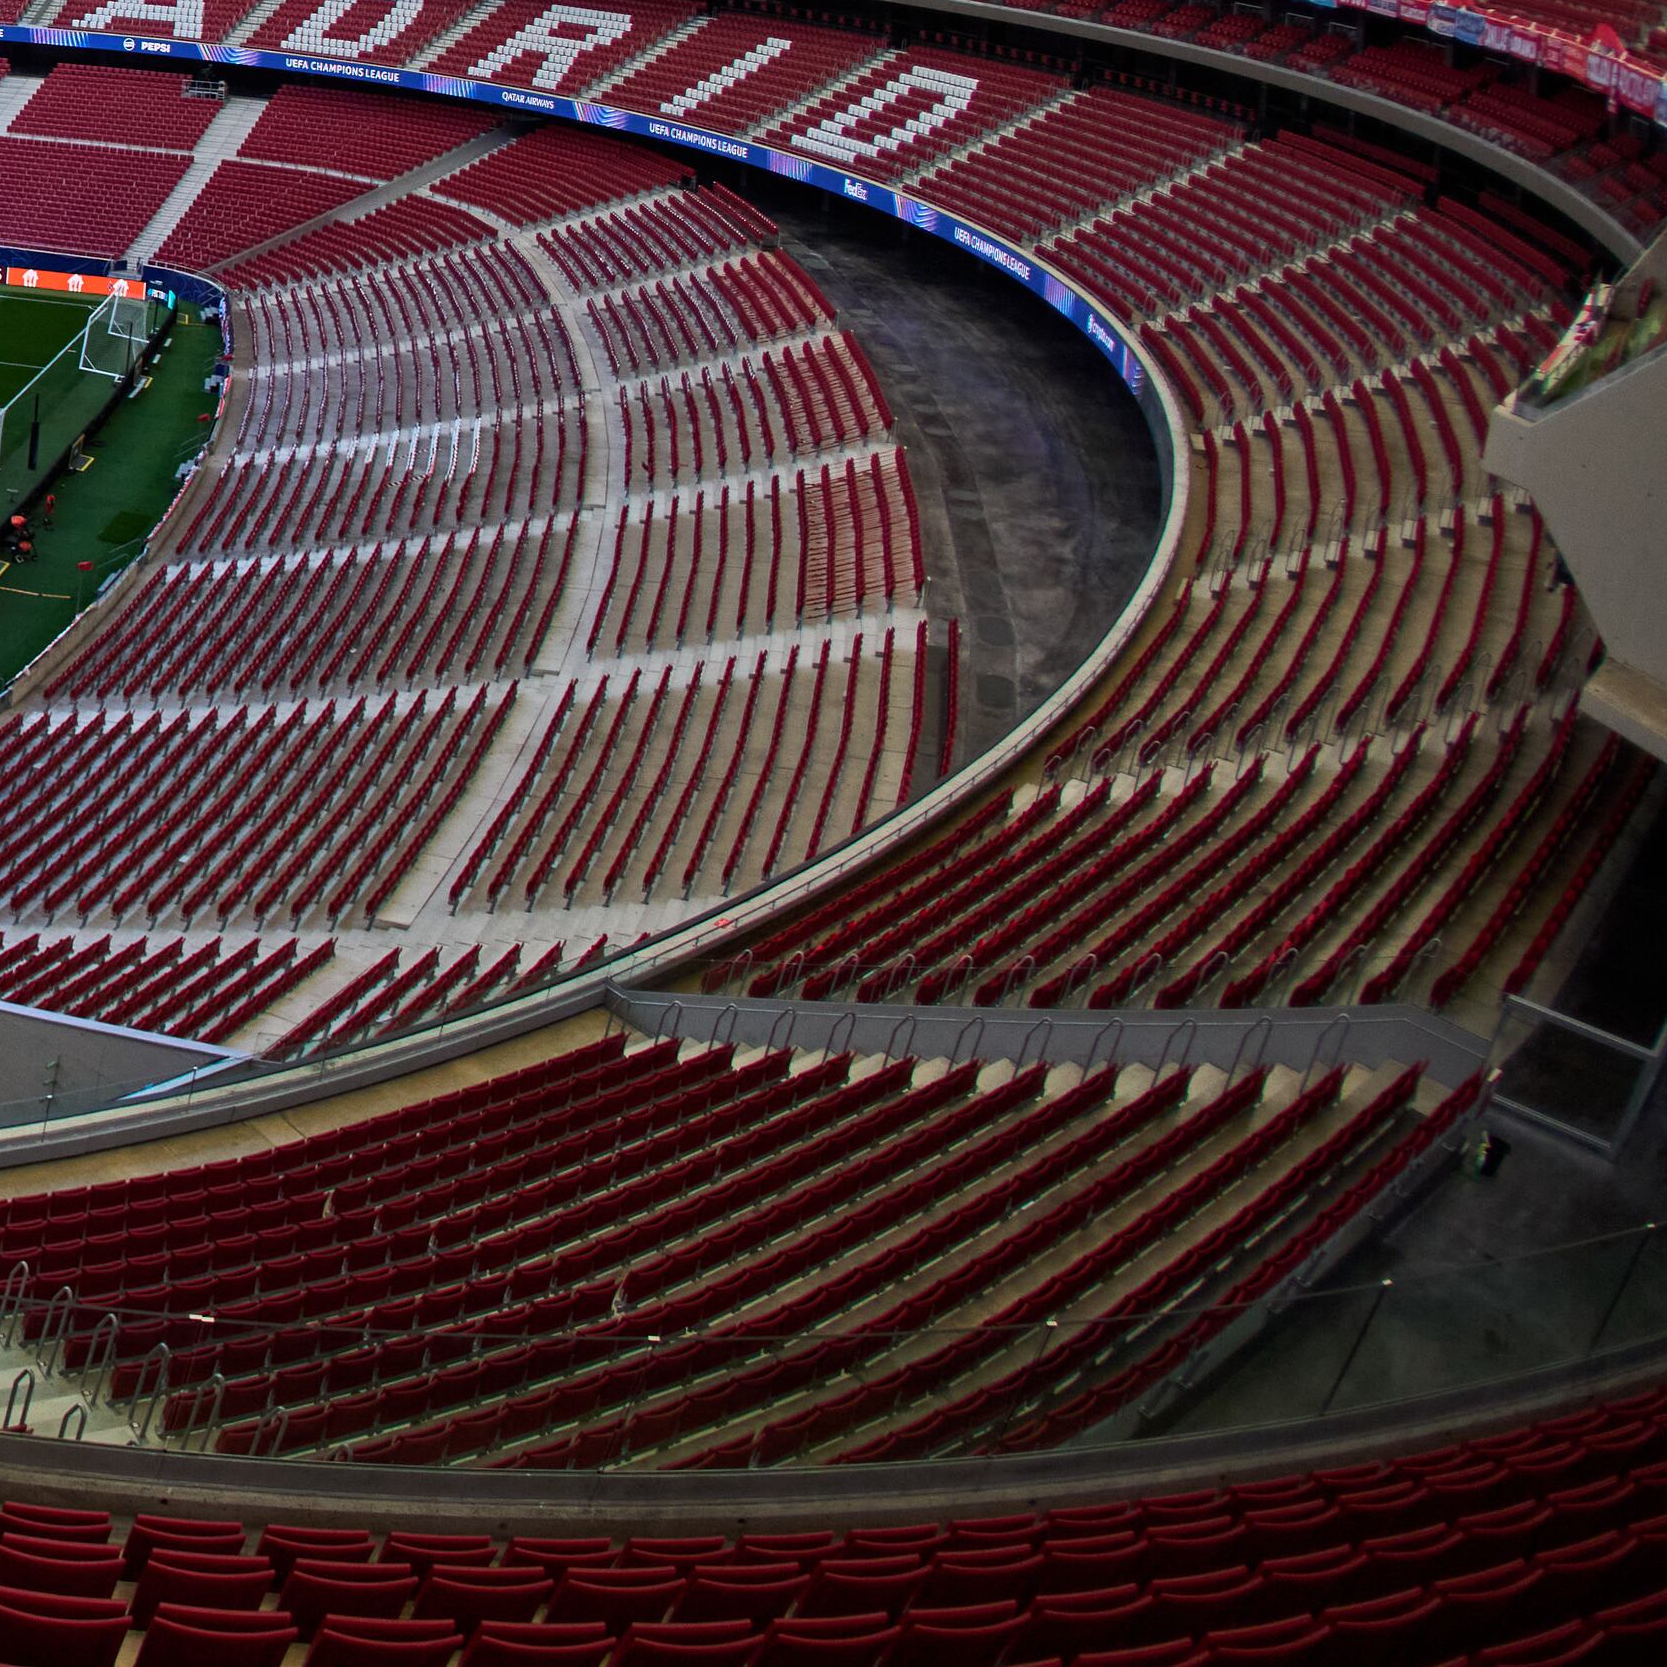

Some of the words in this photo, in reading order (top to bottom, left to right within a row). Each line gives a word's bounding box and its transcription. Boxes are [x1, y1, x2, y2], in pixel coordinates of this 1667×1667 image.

[141, 41, 171, 53] PEPSI
[285, 58, 309, 70] UEFA
[310, 61, 364, 77] CHAMPIONS
[365, 68, 400, 83] LEAGUE
[501, 92, 525, 104] QATAR
[525, 96, 555, 109] AIRWAYS
[649, 122, 669, 137] UEFA
[670, 128, 718, 150] CHAMPIONS
[718, 139, 748, 159] LEAGUE
[844, 178, 868, 200] FedEx
[954, 227, 971, 246] UEFA
[971, 235, 1008, 266] CHAMPIONS
[1006, 254, 1031, 280] LEAGUE
